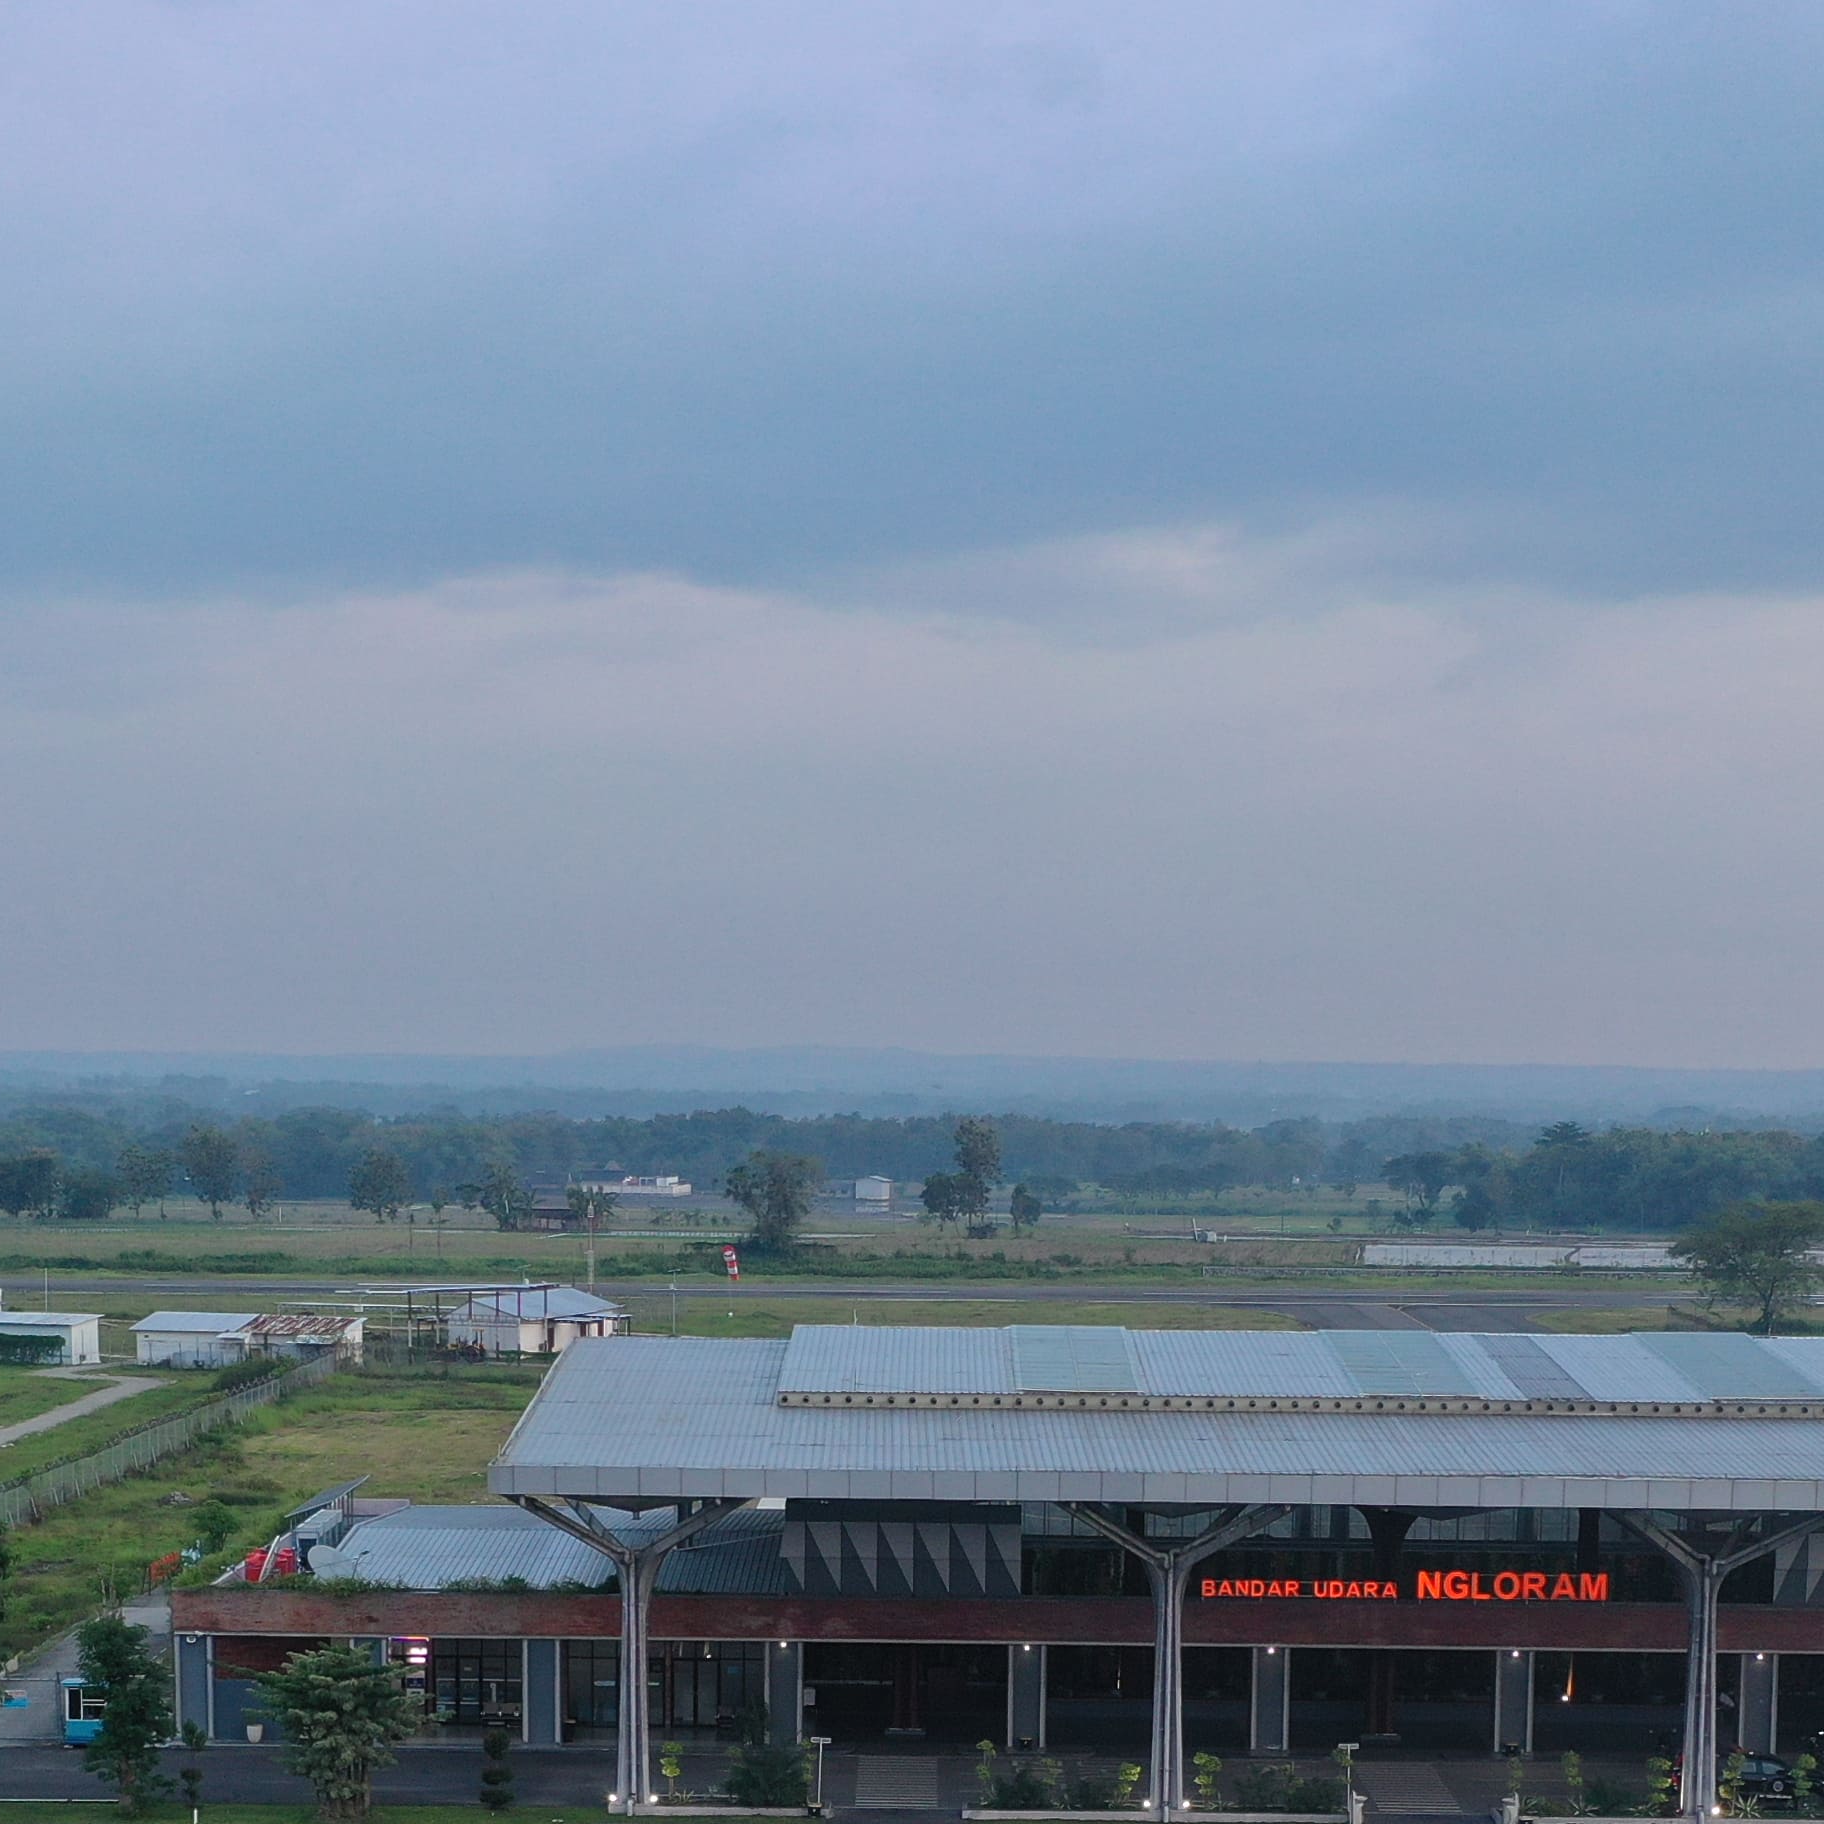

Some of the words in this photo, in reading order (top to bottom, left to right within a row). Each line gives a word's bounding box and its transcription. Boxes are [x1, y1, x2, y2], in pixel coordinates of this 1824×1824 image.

[1201, 1579, 1301, 1598] BANDAR
[1313, 1580, 1398, 1599] UDARA
[1417, 1570, 1609, 1600] NGLORAM
